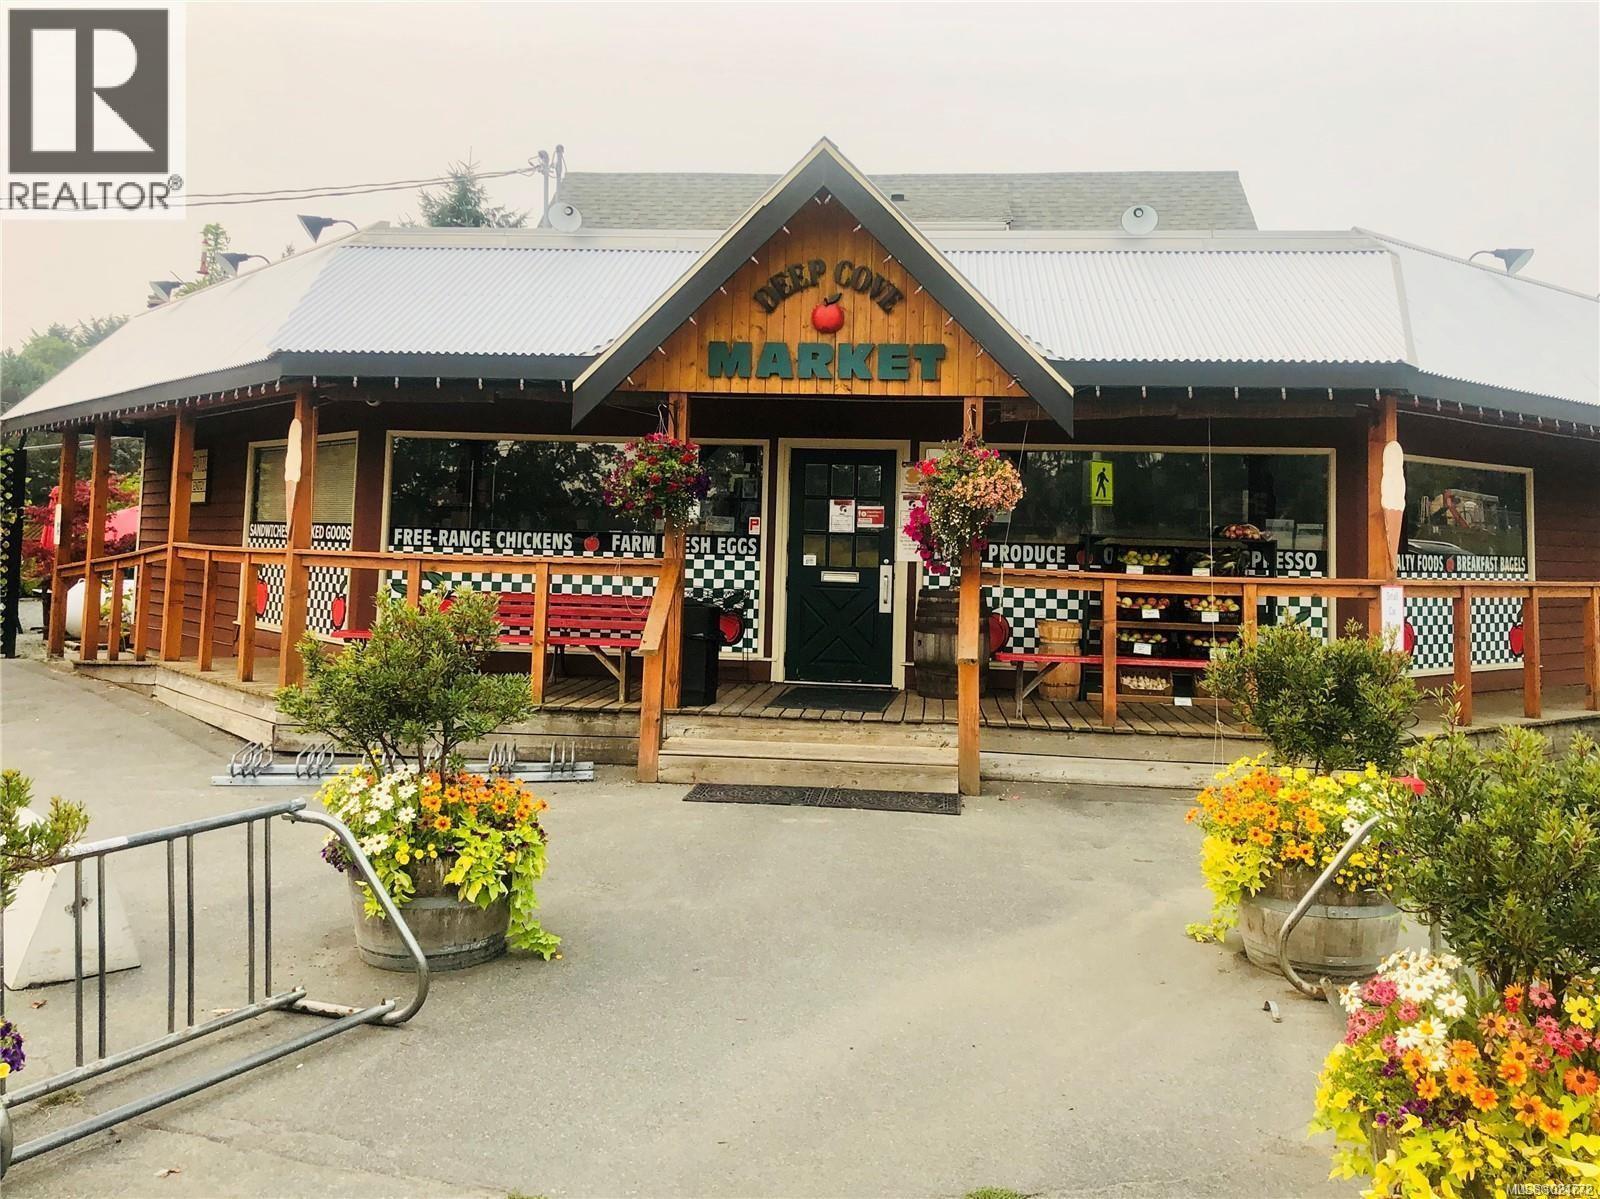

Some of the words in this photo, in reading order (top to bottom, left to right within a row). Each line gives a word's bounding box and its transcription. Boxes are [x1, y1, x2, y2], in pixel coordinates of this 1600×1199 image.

[753, 259, 826, 314] DEEP
[833, 260, 904, 313] COVE
[708, 341, 946, 380] MARKET
[325, 525, 352, 540] GOODS
[394, 528, 491, 547] FREE-RANGE
[496, 531, 573, 550] CHICKENS
[611, 534, 655, 553] FARM
[717, 537, 757, 555] EGGS
[988, 544, 1066, 563] PRODUCE
[1251, 551, 1317, 570] PESSO
[1417, 554, 1444, 572] FOODS
[1456, 555, 1498, 572] BREAKFAST
[1500, 556, 1526, 572] BAGELS
